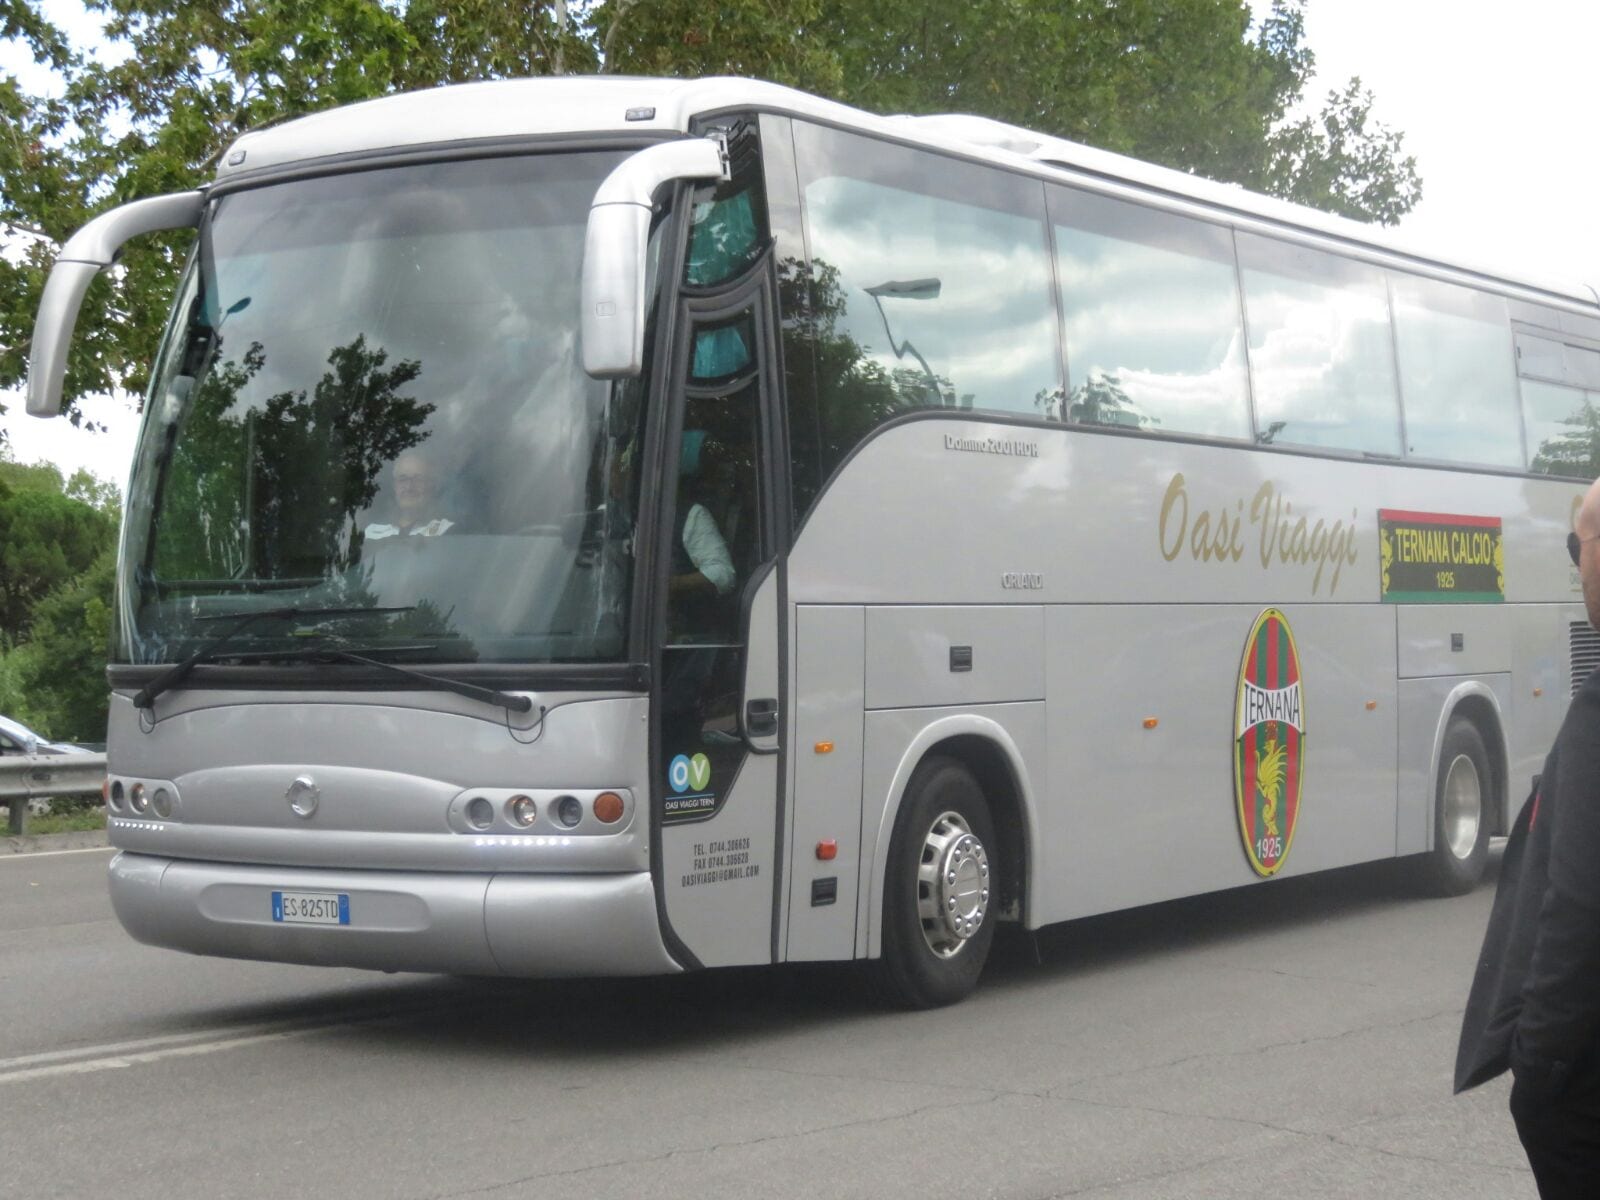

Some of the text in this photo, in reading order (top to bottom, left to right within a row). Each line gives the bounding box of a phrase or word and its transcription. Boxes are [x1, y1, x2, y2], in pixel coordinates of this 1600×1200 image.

[1159, 472, 1358, 597] Oasi Viaggi
[1395, 528, 1492, 566] TERNANA CALCIO
[1436, 572, 1455, 589] 1925
[1244, 683, 1301, 729] TERNANA
[665, 801, 679, 810] OASI
[680, 799, 699, 809] VIAGGI
[1256, 837, 1282, 859] 1925
[694, 858, 706, 871] FAX
